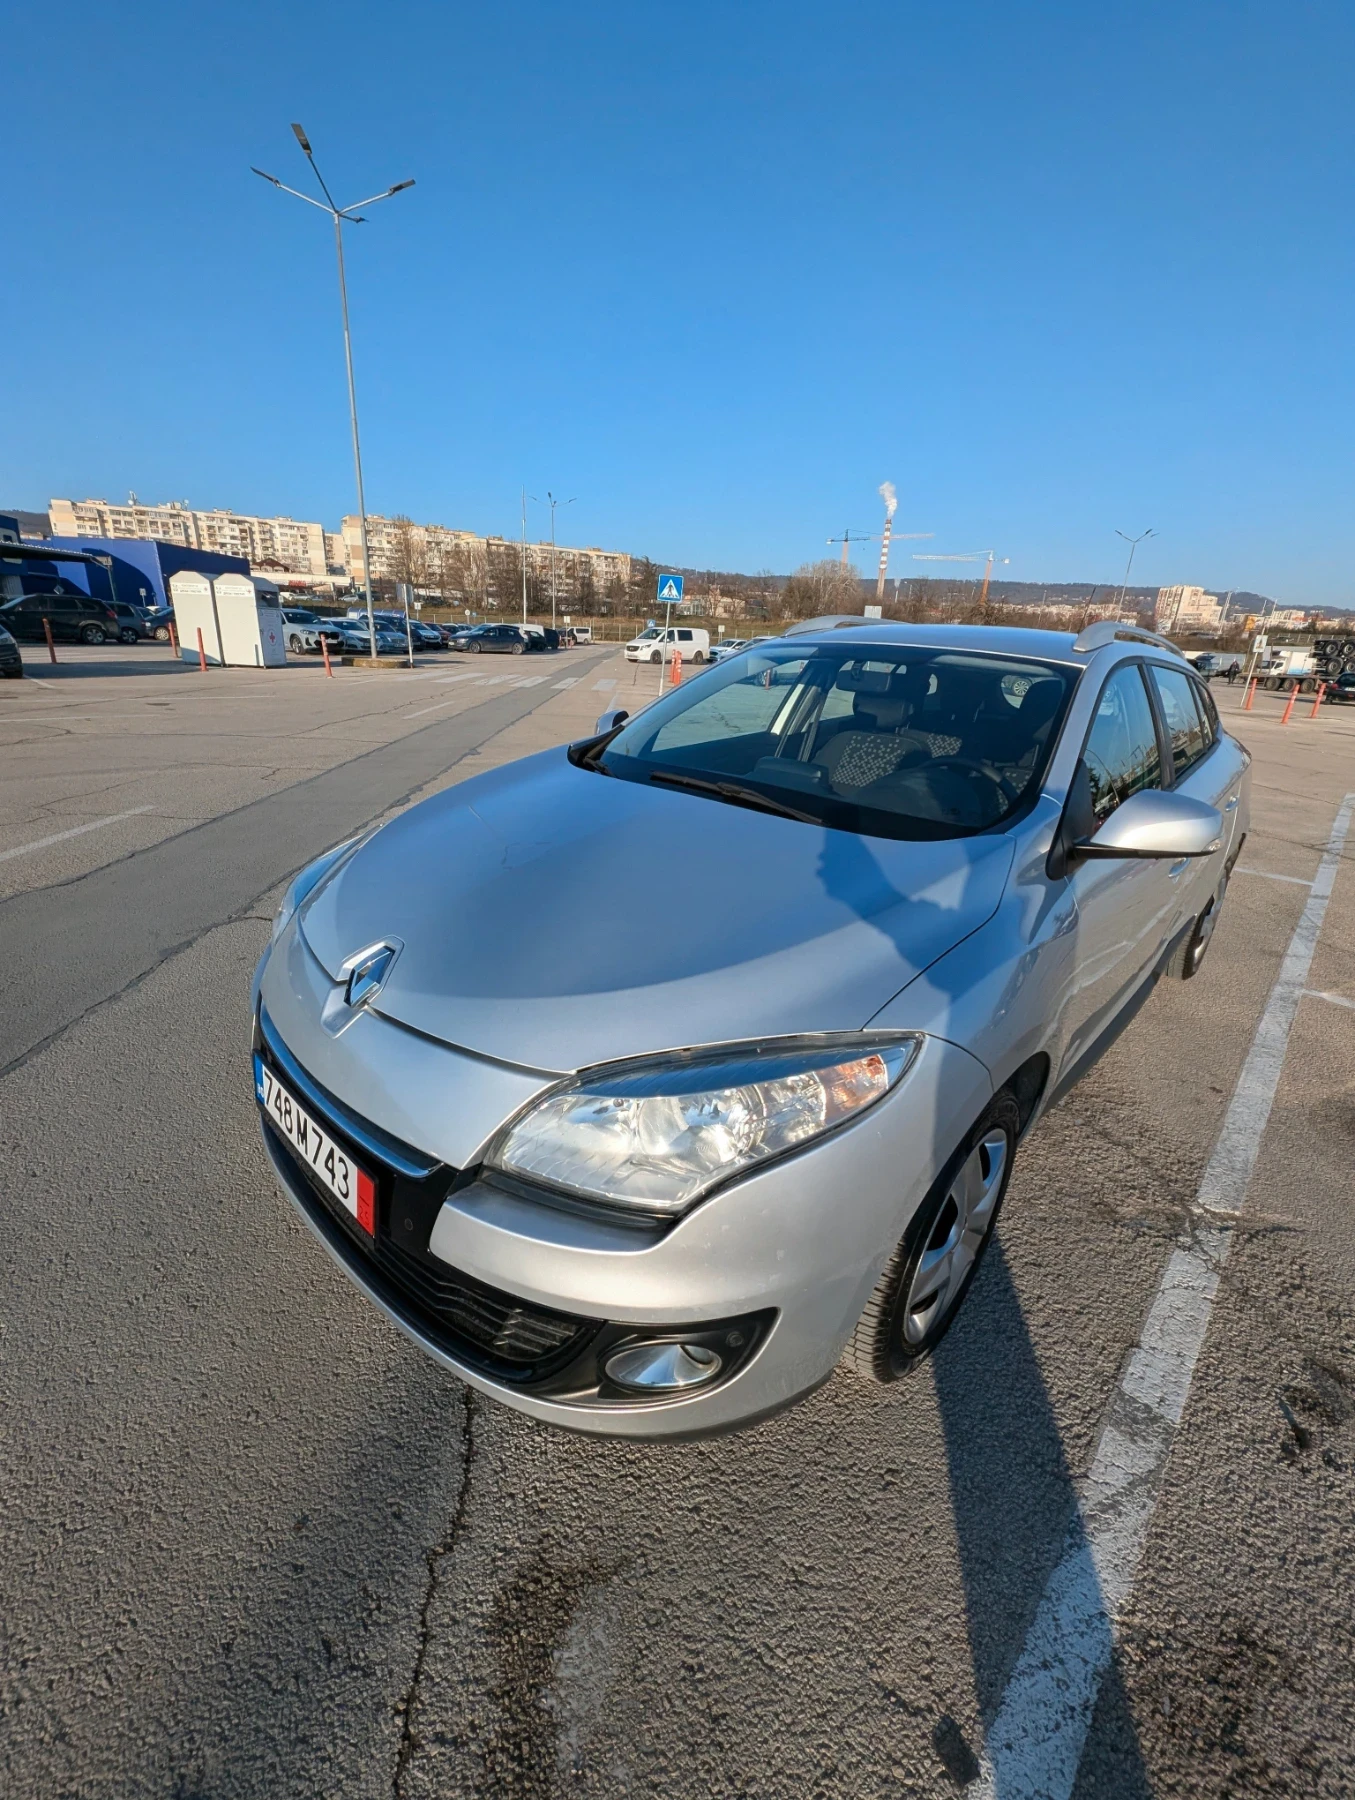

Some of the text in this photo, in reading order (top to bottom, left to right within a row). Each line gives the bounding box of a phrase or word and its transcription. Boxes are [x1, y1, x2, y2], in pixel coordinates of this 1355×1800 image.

[265, 1072, 350, 1200] 748 M 743
